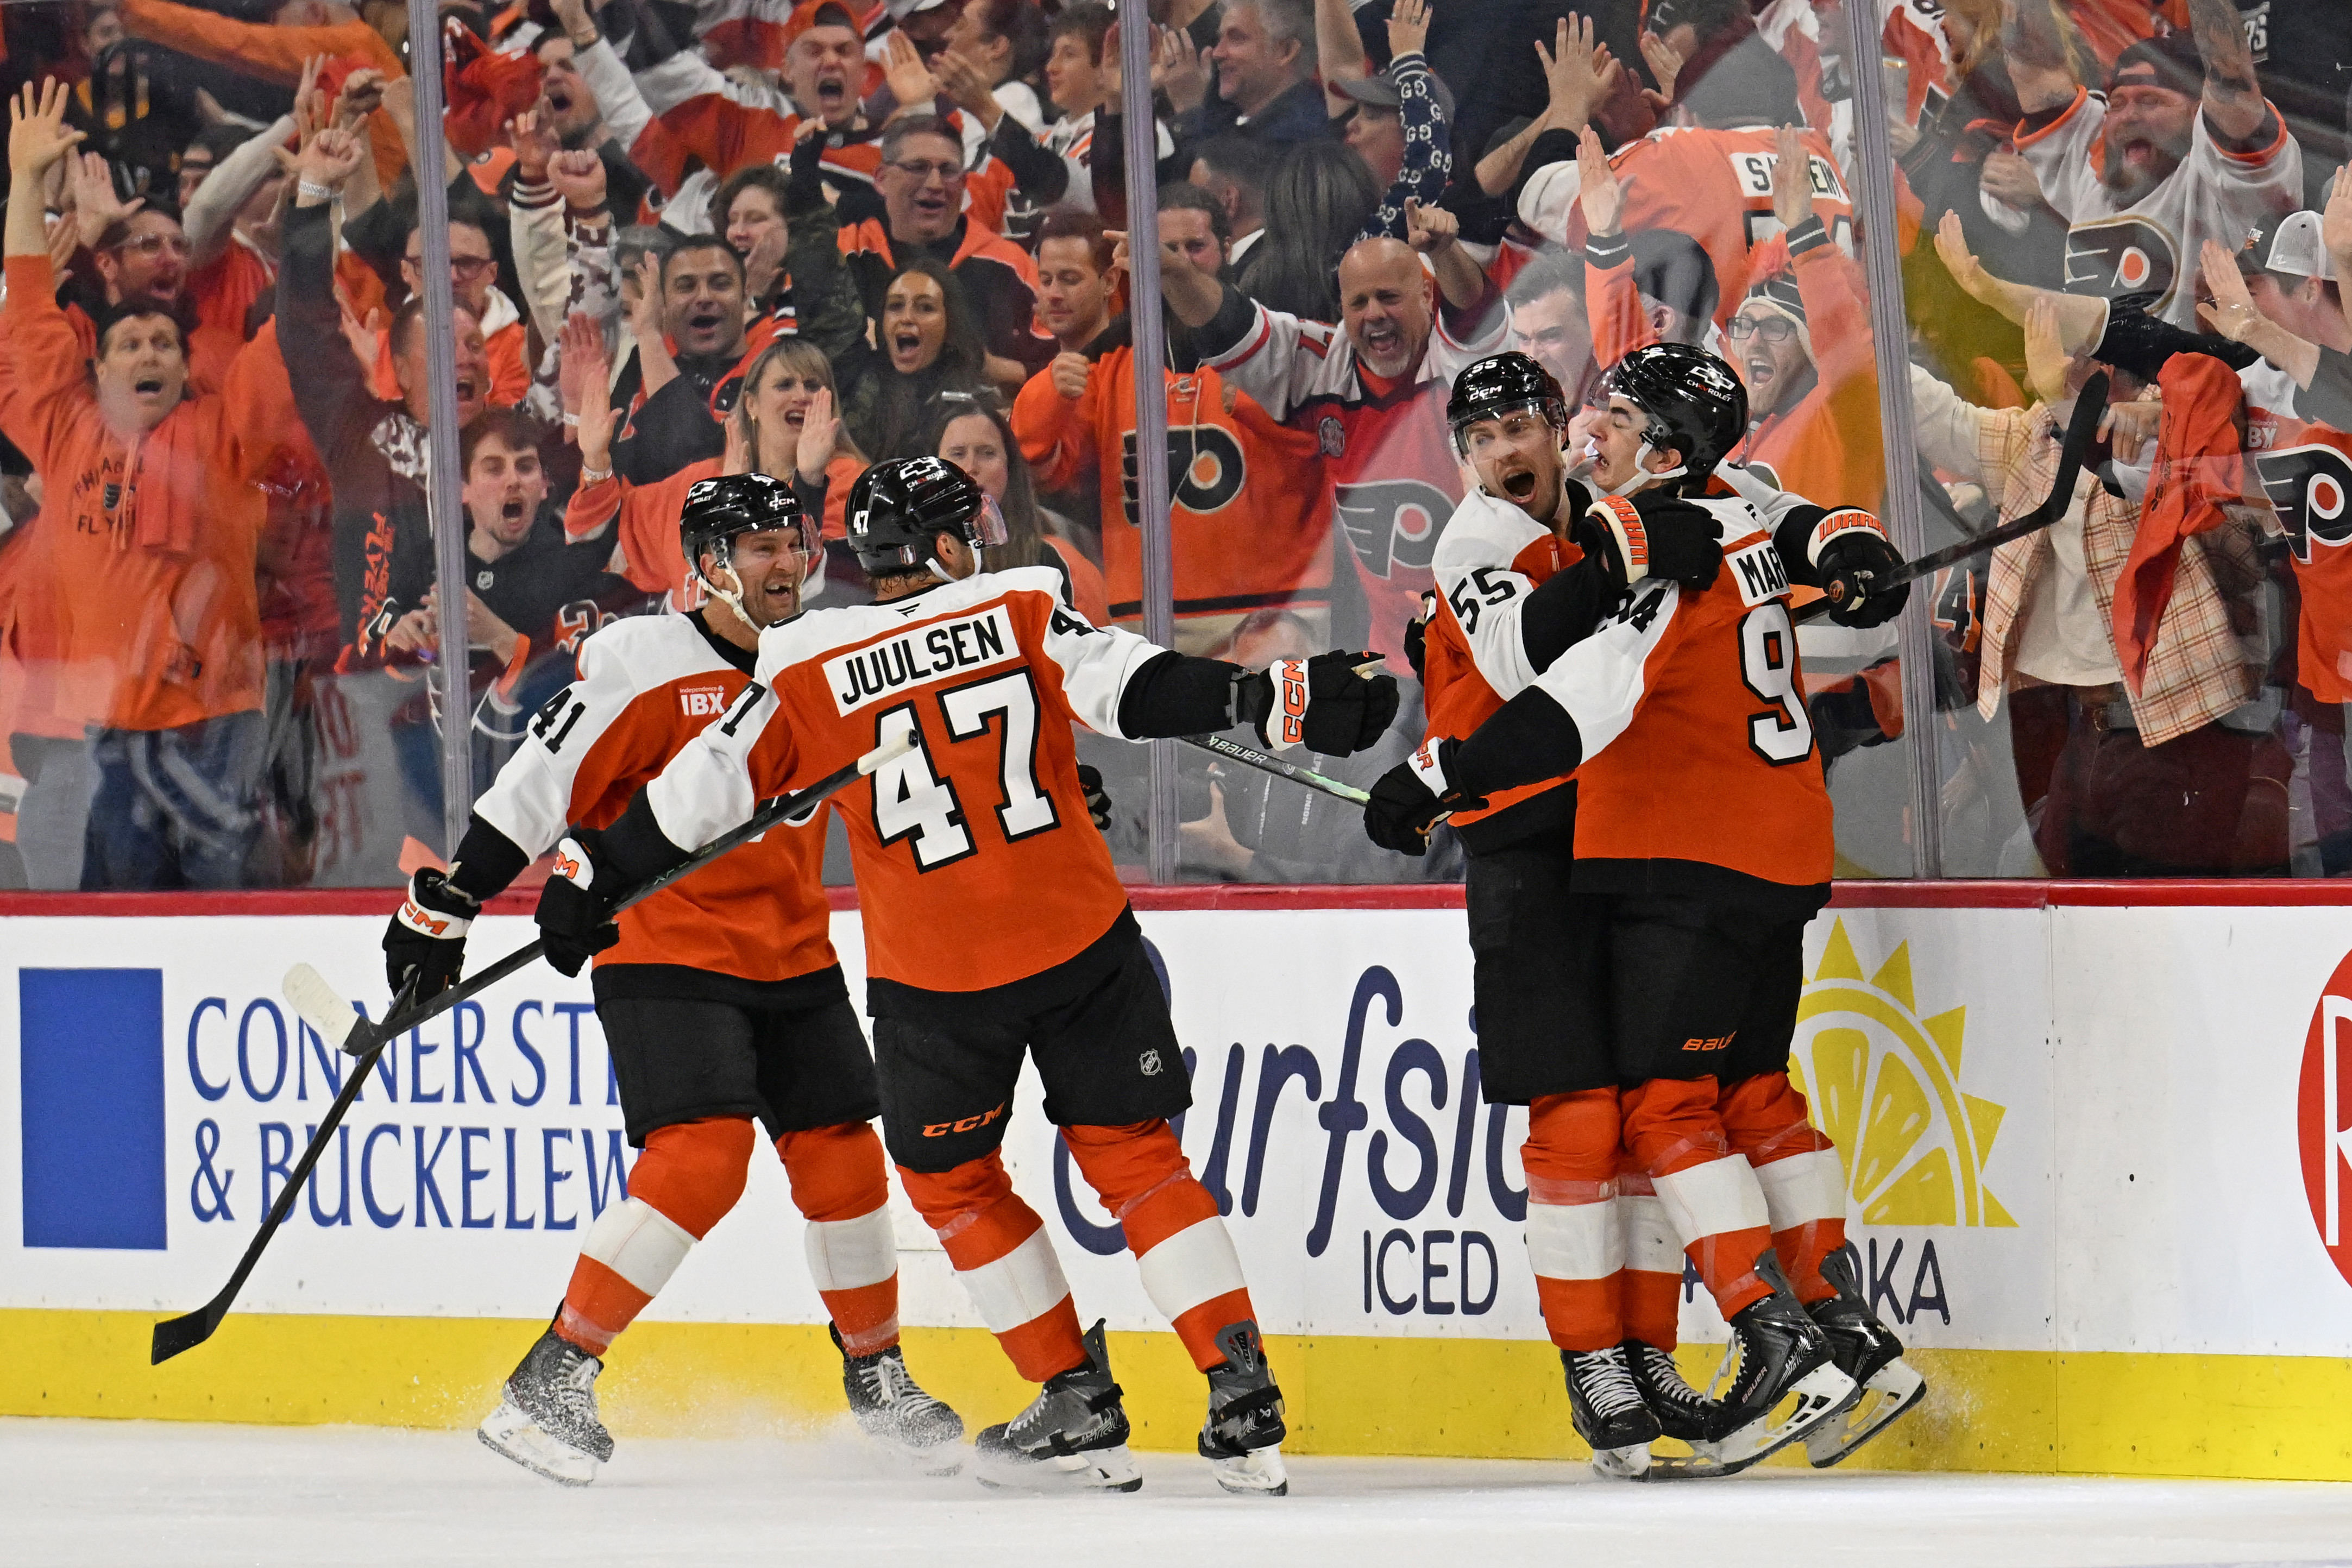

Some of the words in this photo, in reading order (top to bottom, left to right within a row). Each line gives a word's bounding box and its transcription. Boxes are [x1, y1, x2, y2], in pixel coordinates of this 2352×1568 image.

[1471, 359, 1499, 374] 55
[1686, 379, 1732, 402] CHEVROLET
[769, 497, 796, 508] CCM
[853, 510, 869, 534] 47
[1449, 566, 1516, 635] 55
[680, 685, 718, 694] Independence
[842, 615, 1005, 706] JUULSEN
[532, 688, 586, 754] 41
[681, 692, 725, 716] IBX
[1282, 659, 1305, 744] CCM
[869, 665, 1062, 875] 47
[187, 996, 498, 1105] CONNER
[511, 998, 624, 1107] ST
[922, 1101, 1005, 1138] CCM
[190, 1117, 235, 1223] &
[259, 1120, 643, 1231] BUCKELEW
[1363, 1228, 1498, 1315] ICED
